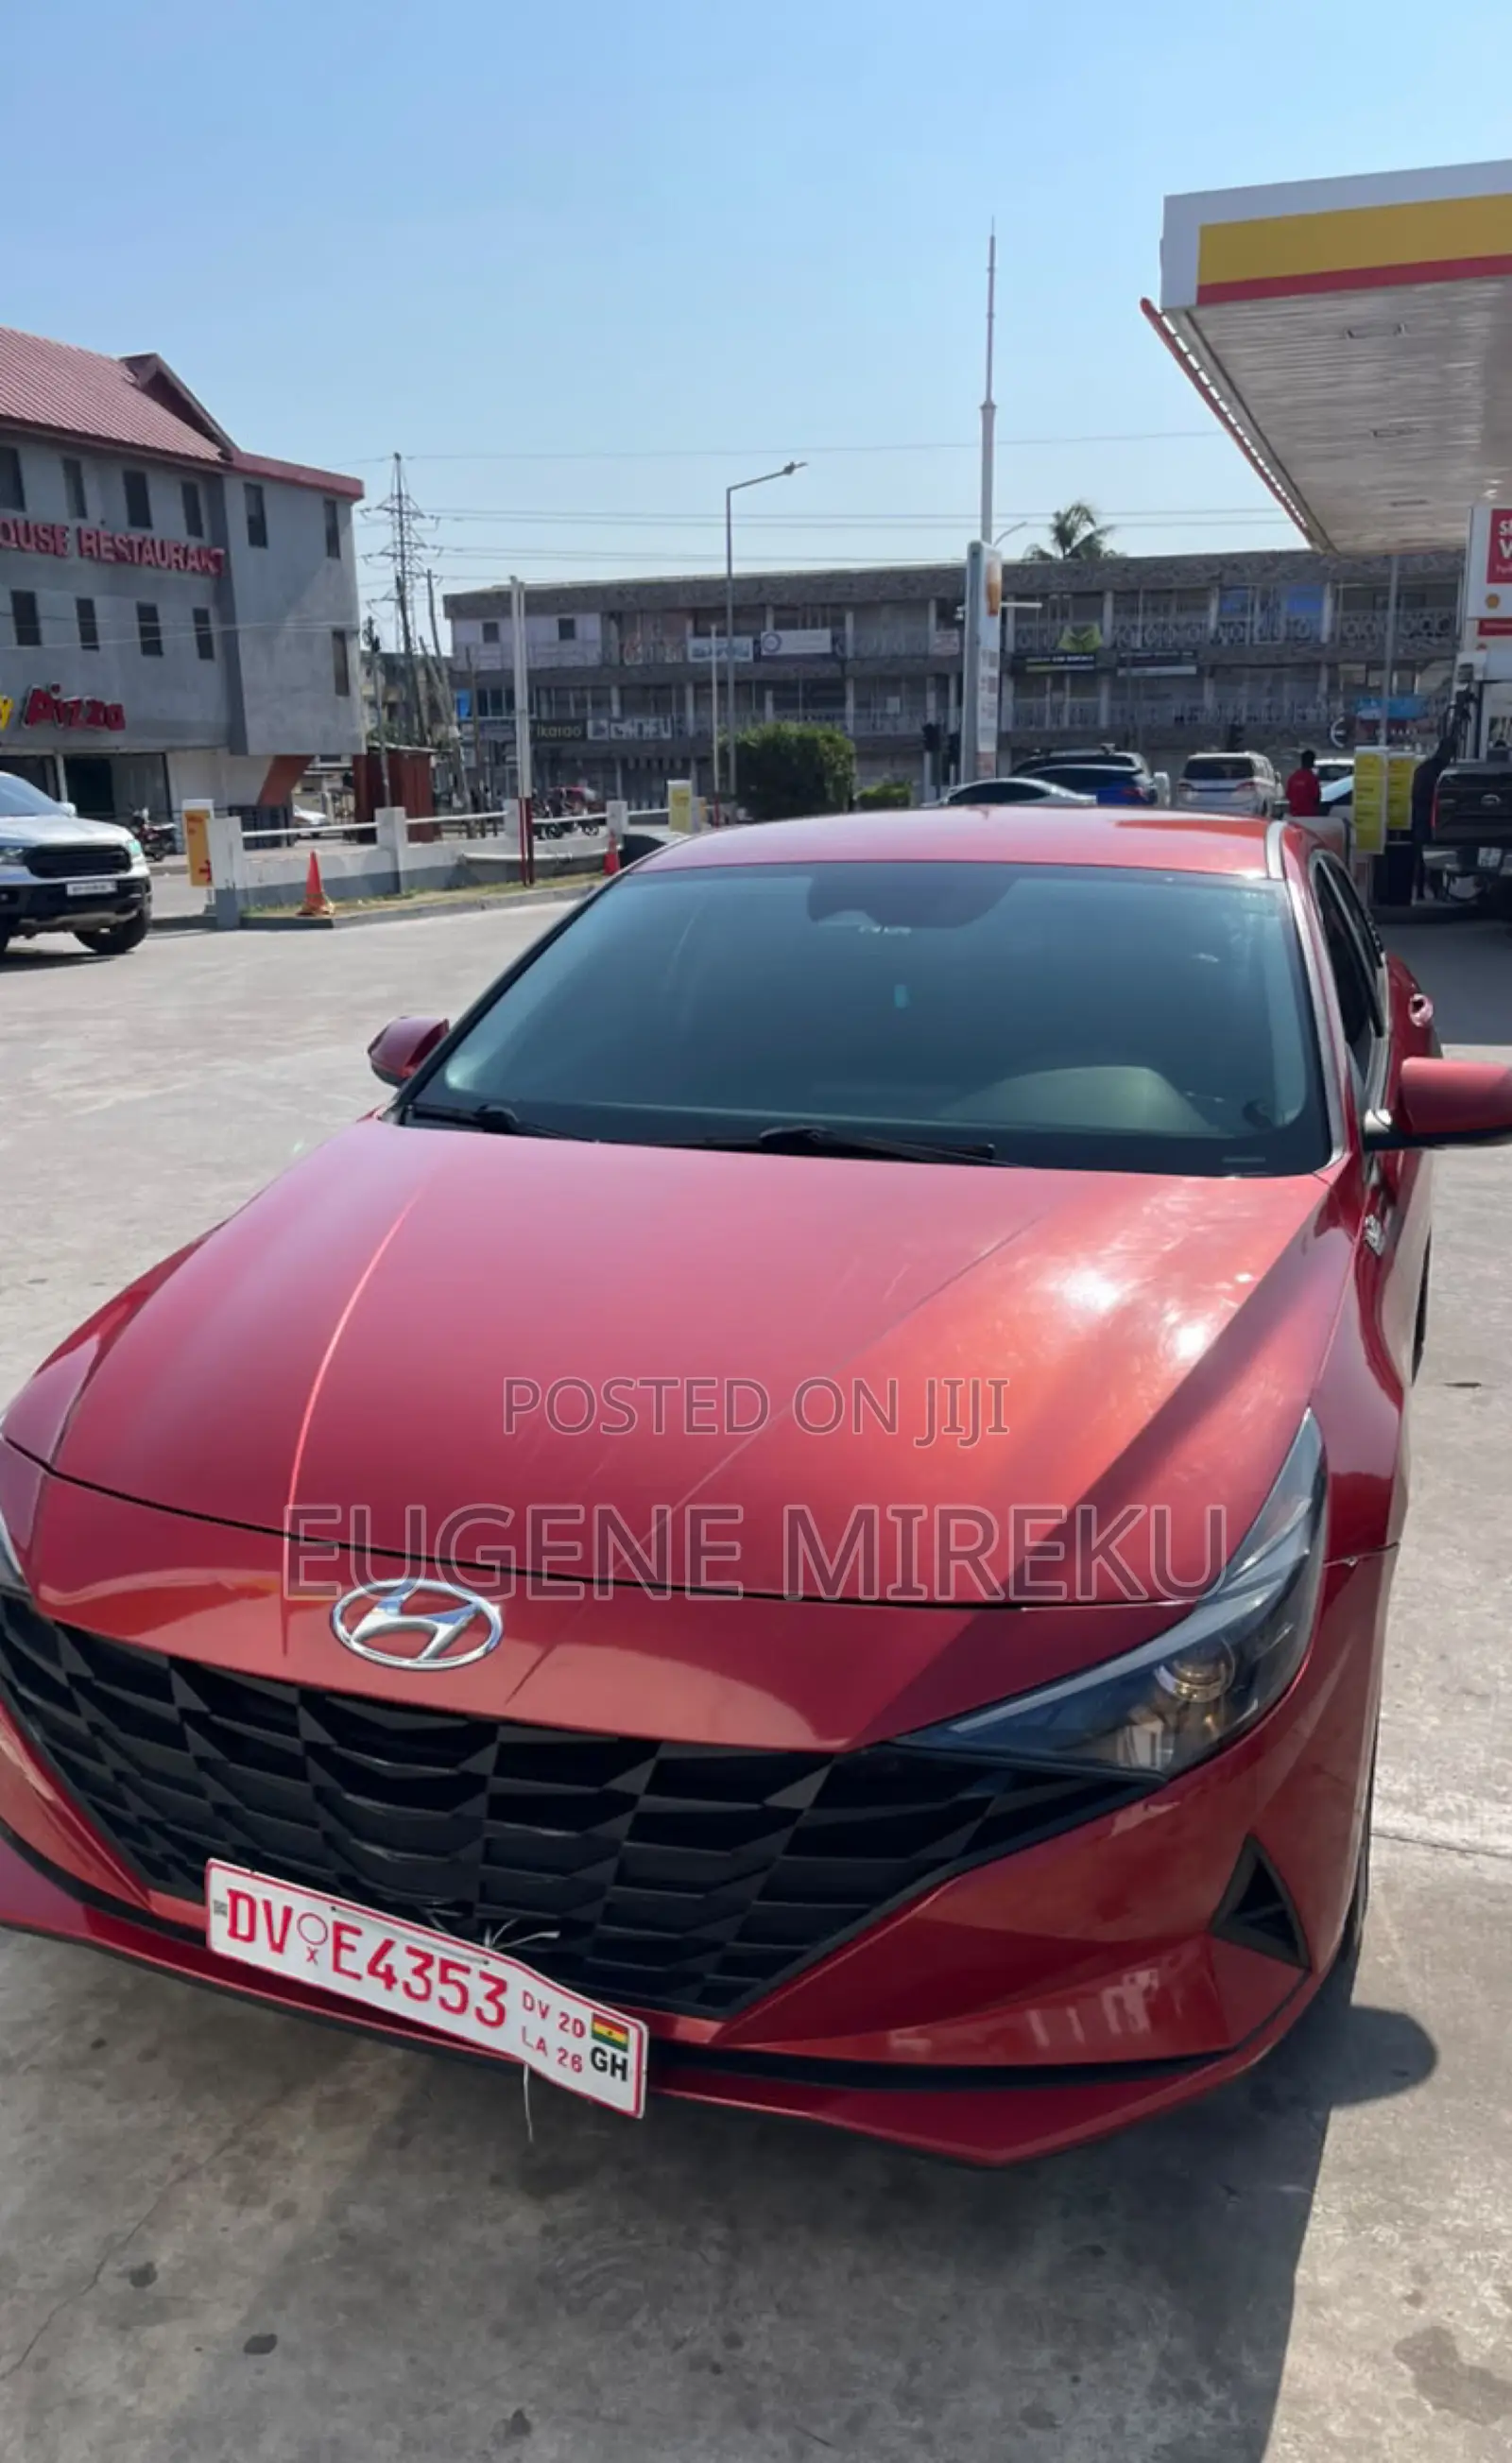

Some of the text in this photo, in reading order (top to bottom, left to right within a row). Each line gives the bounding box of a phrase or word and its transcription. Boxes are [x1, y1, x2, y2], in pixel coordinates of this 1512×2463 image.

[77, 525, 226, 577] RESTAURANT
[23, 681, 127, 732] Pizza
[227, 1887, 508, 2029] DV E4353
[522, 1989, 551, 2021] DV
[521, 2024, 548, 2058] LA
[590, 2045, 629, 2083] GH
